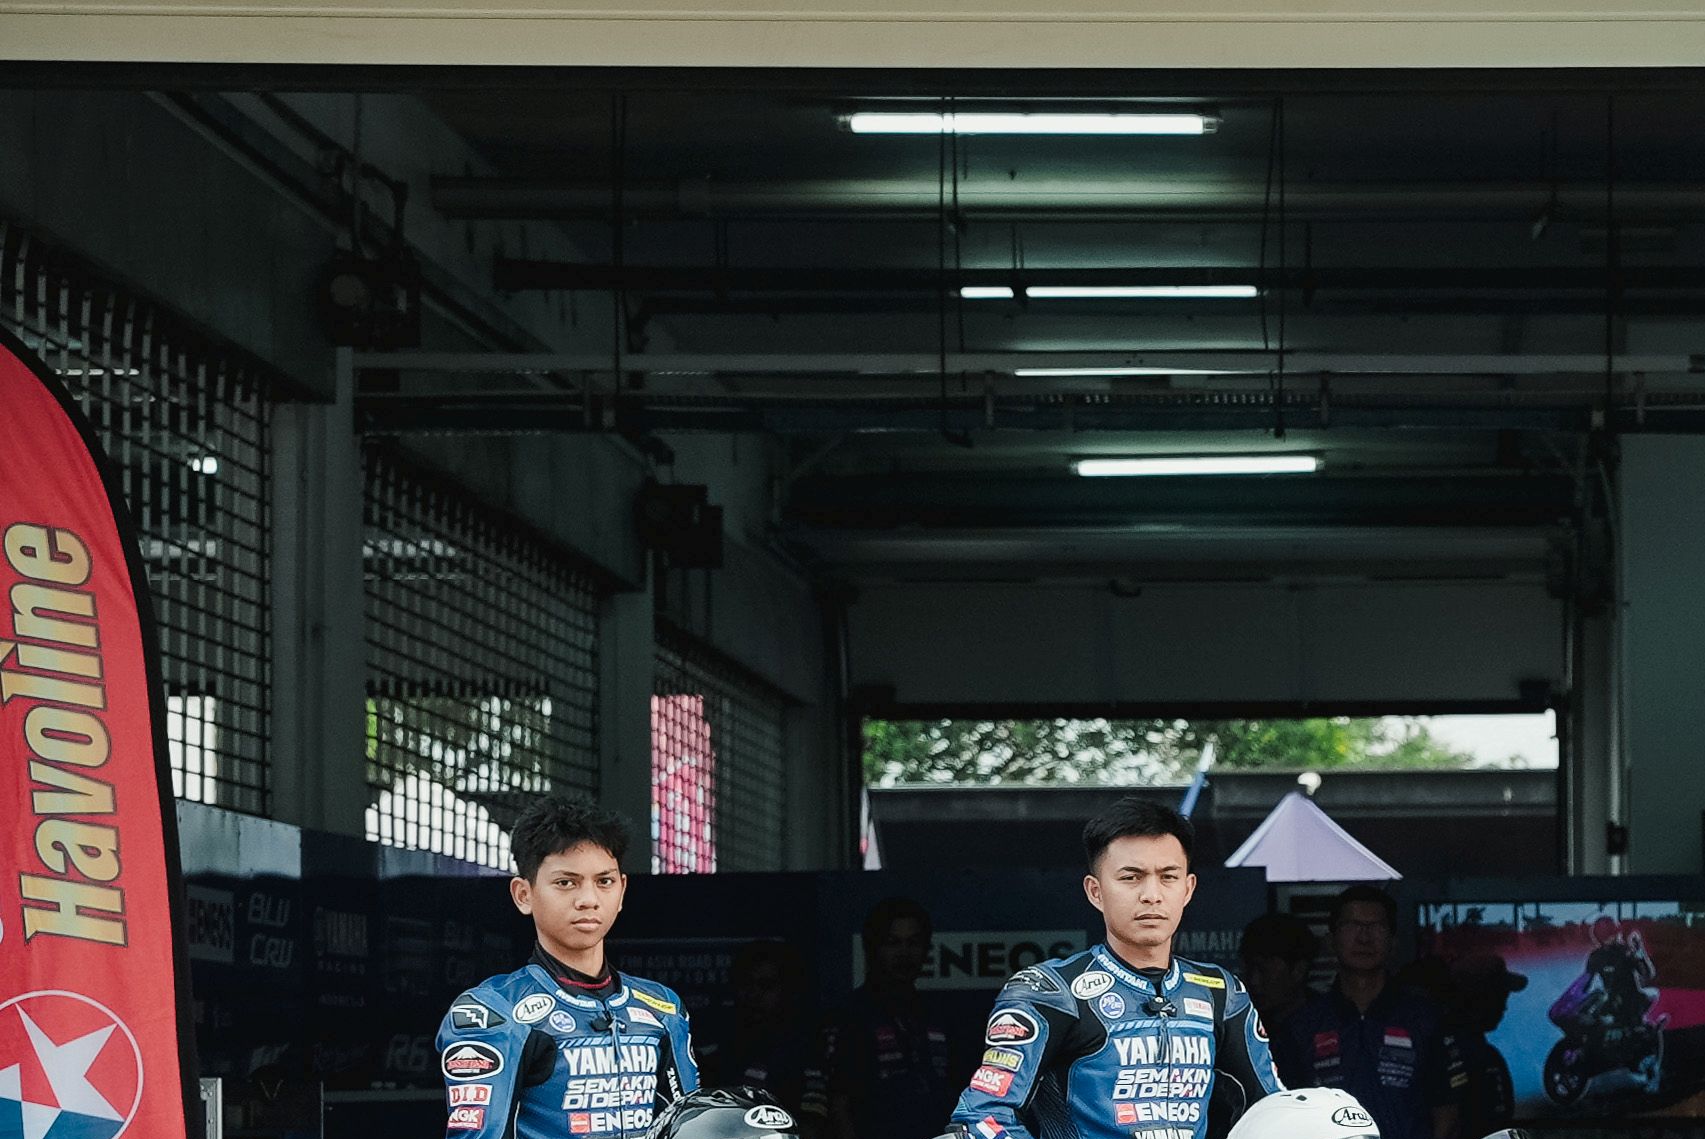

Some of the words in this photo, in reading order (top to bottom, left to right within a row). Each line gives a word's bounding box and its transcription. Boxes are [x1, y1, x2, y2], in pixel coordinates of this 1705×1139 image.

[2, 520, 129, 948] Havoline
[563, 1045, 658, 1076] YAMAHA
[1113, 1036, 1211, 1066] YAMAHA
[566, 1074, 658, 1094] SEMAKIN
[975, 1068, 1004, 1087] NGK
[1117, 1069, 1211, 1084] SEMAKIN
[562, 1093, 588, 1110] DI
[591, 1089, 655, 1108] DEPAN
[1112, 1084, 1137, 1100] DI
[1139, 1084, 1208, 1099] DEPAN
[591, 1108, 653, 1132] ENEOS
[748, 1107, 791, 1124] Arai
[1138, 1103, 1200, 1122] ENEOS
